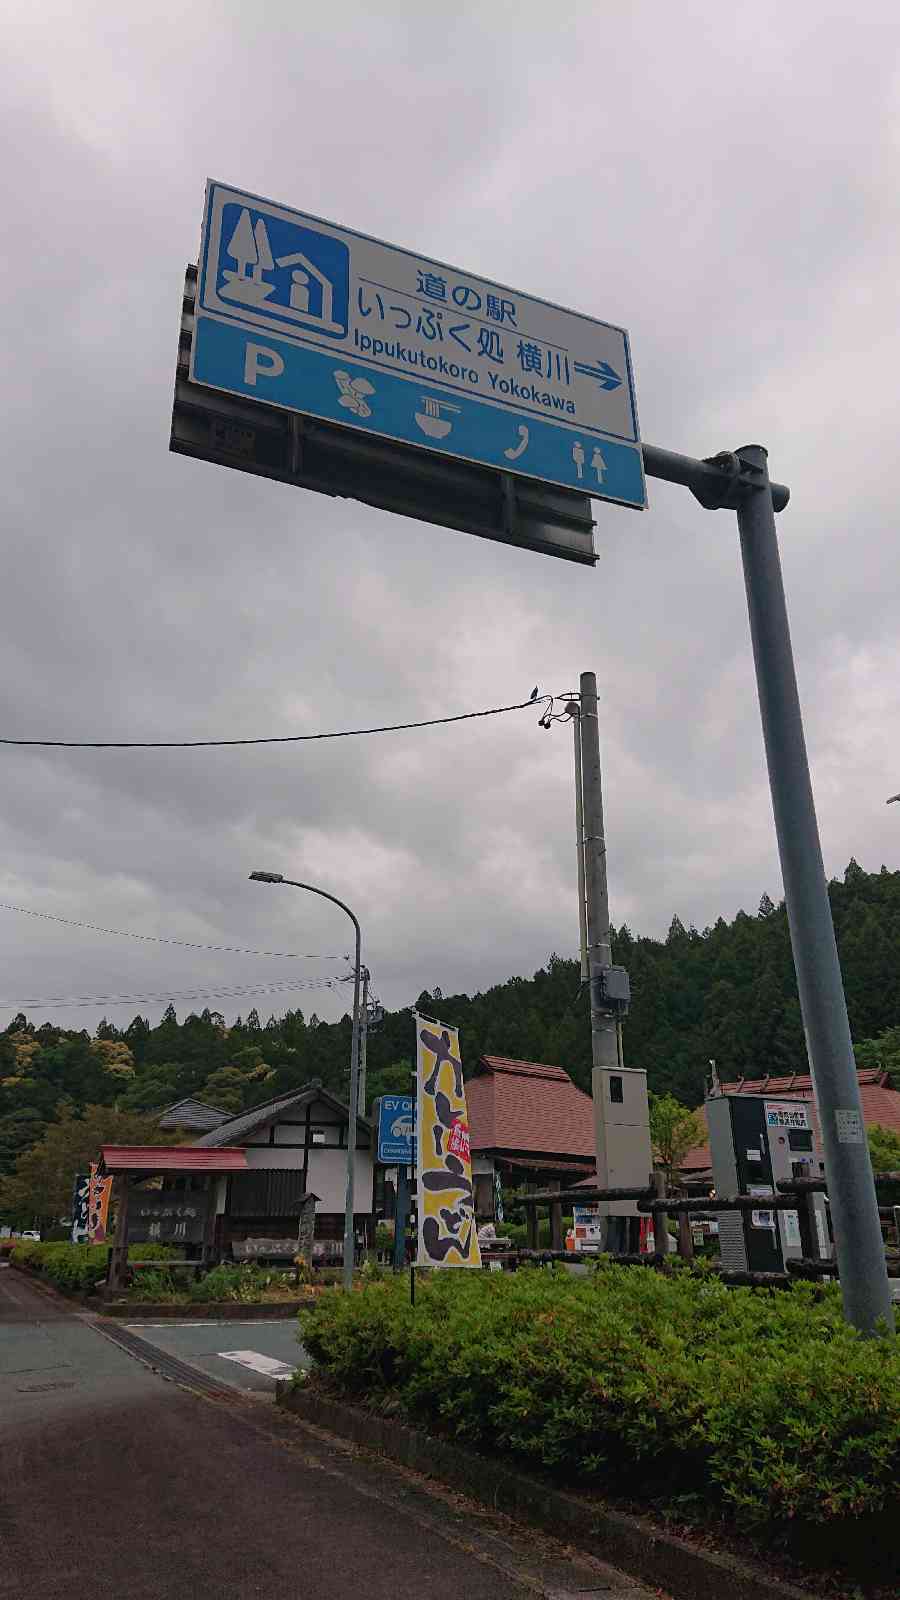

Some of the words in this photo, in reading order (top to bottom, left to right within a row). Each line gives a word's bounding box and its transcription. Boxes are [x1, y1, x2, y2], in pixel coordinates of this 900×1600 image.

[416, 270, 518, 327] 道の駅
[244, 341, 285, 386] P
[357, 287, 504, 365] いっぷく処
[516, 340, 570, 385] 横川
[355, 328, 480, 384] Ippukutokoro
[487, 373, 576, 414] Yokokawa
[384, 1101, 399, 1110] EV
